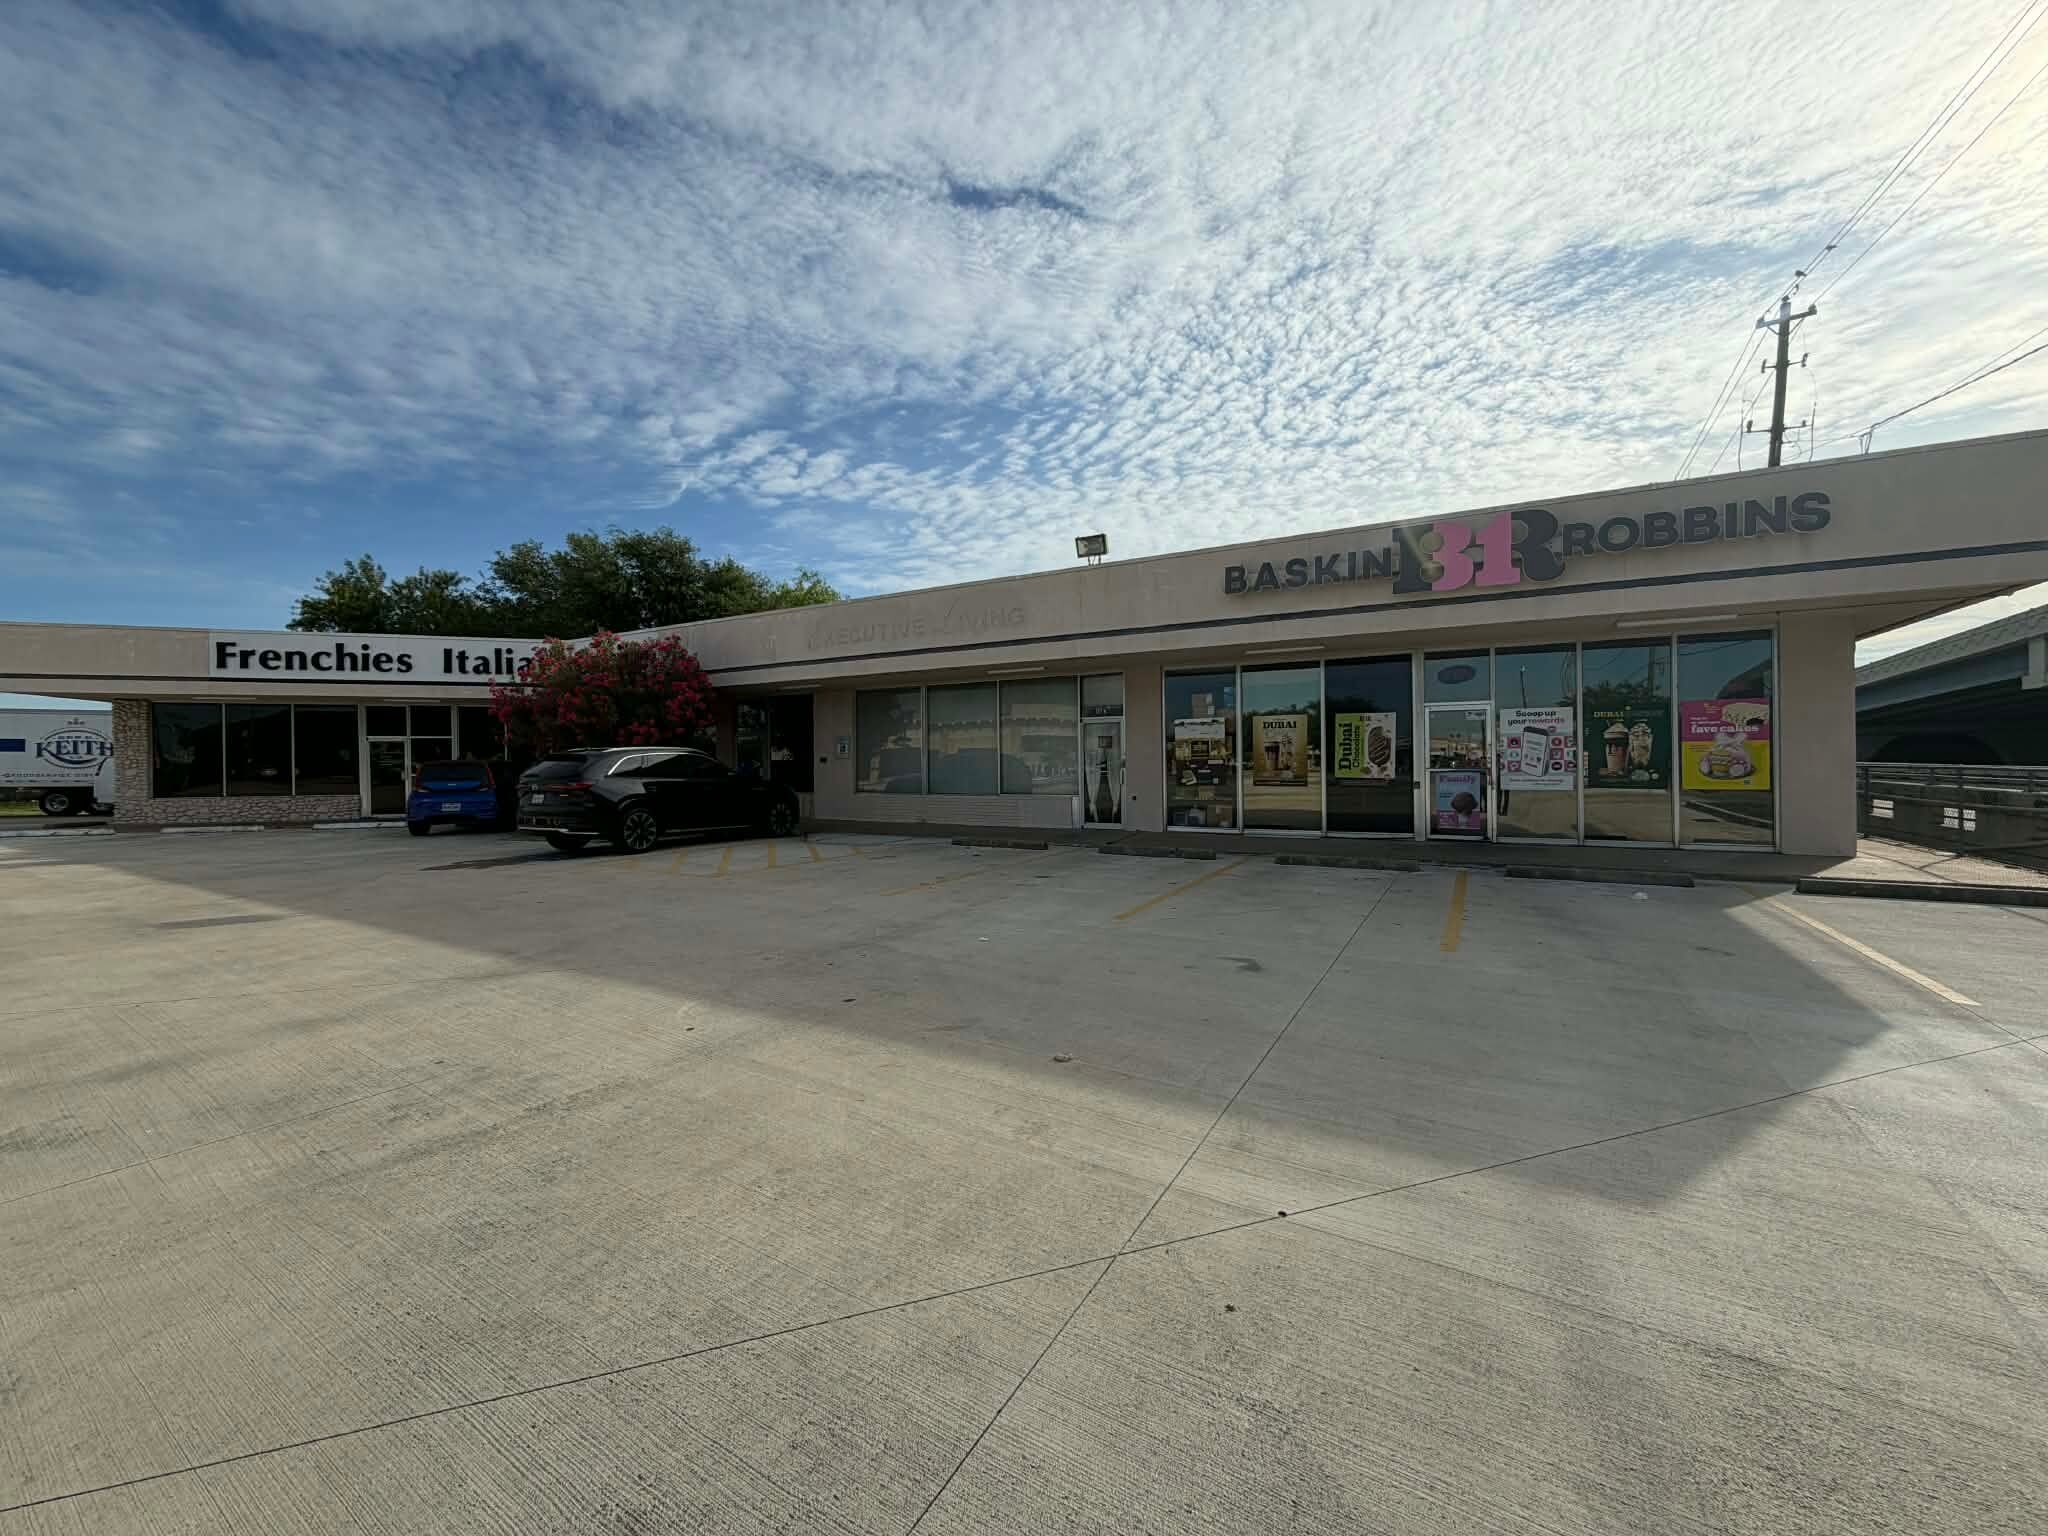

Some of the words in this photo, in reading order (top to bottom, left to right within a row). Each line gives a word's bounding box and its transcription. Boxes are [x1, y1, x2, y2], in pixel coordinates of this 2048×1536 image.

[1223, 546, 1392, 596] BASKIN
[1562, 491, 1832, 557] ROBBINS
[215, 641, 413, 673] Frenchies
[1507, 718, 1527, 726] your
[1515, 710, 1544, 718] Scoop
[1690, 724, 1718, 734] fave
[1719, 724, 1760, 734] cakes
[35, 740, 113, 759] KEITH
[1338, 723, 1353, 770] Dubai
